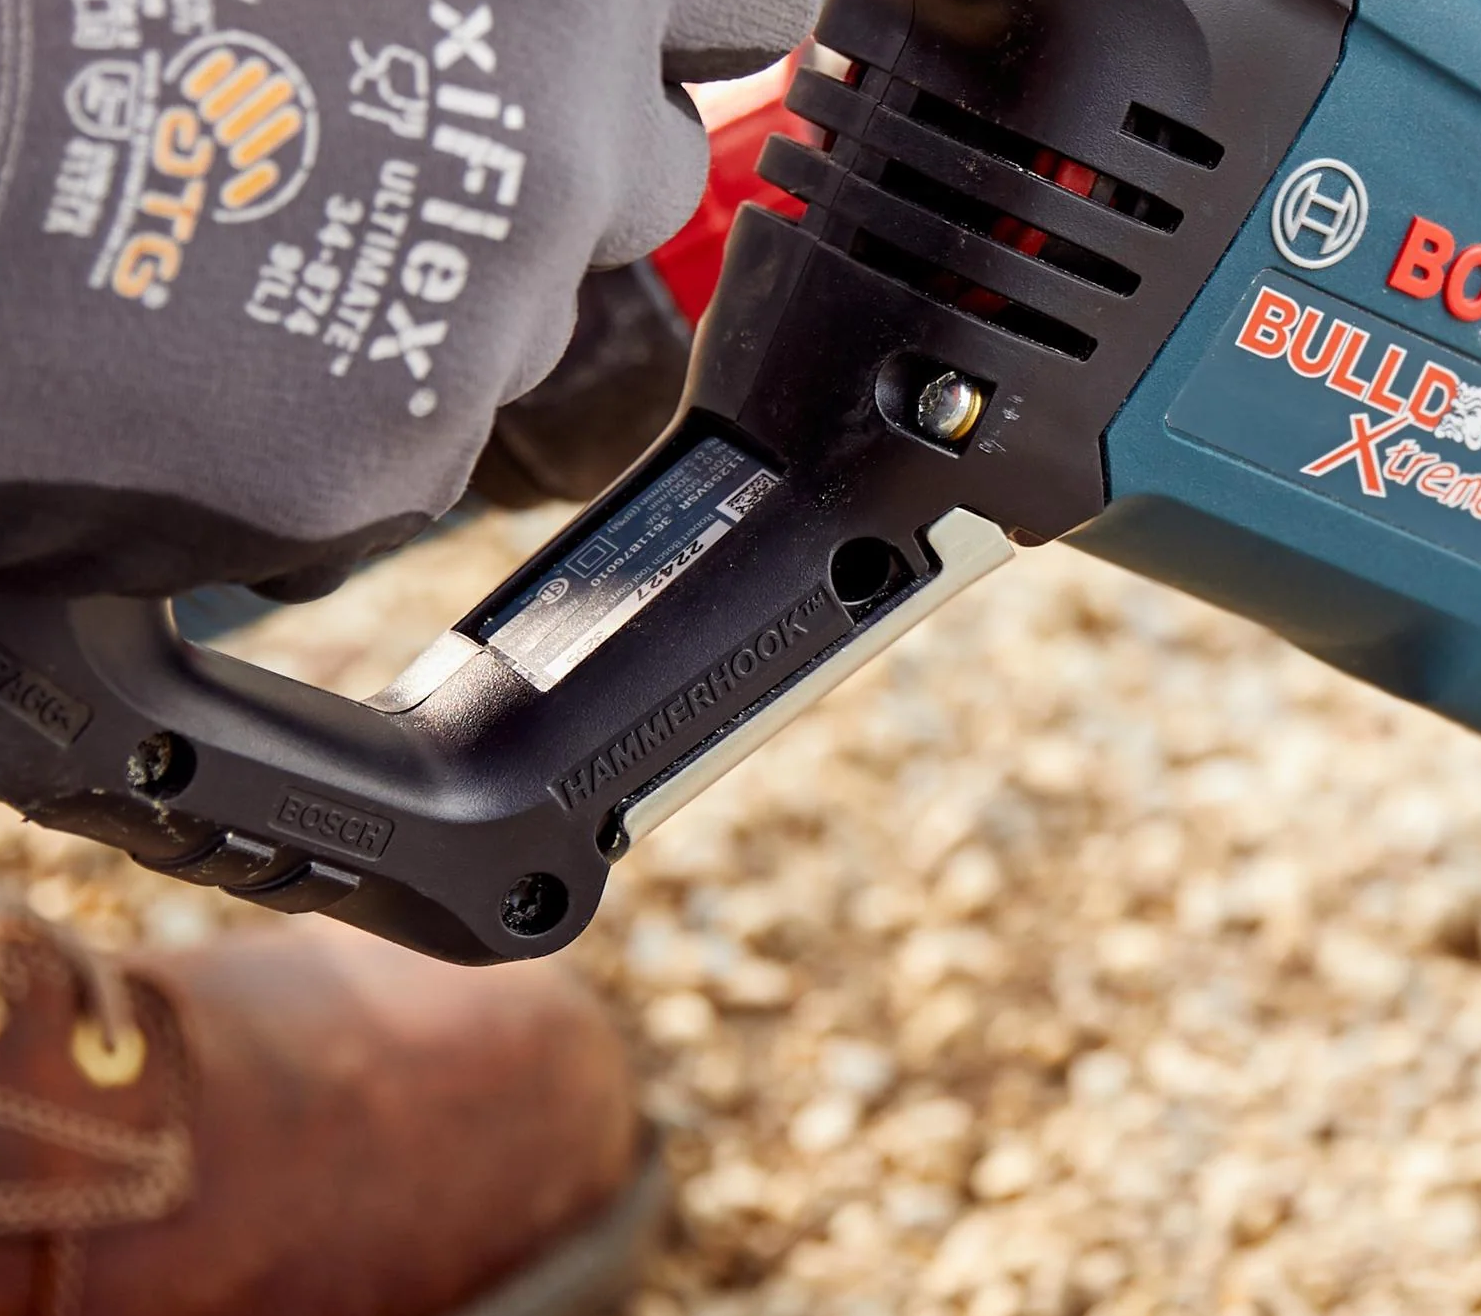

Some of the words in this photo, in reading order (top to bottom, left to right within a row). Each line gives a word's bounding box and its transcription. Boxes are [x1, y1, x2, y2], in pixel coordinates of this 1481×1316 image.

[680, 511, 715, 542] Robert
[650, 538, 683, 566] Bosch
[630, 563, 654, 584] Tool
[634, 538, 705, 602] 22427
[276, 794, 384, 852] BOSCH
